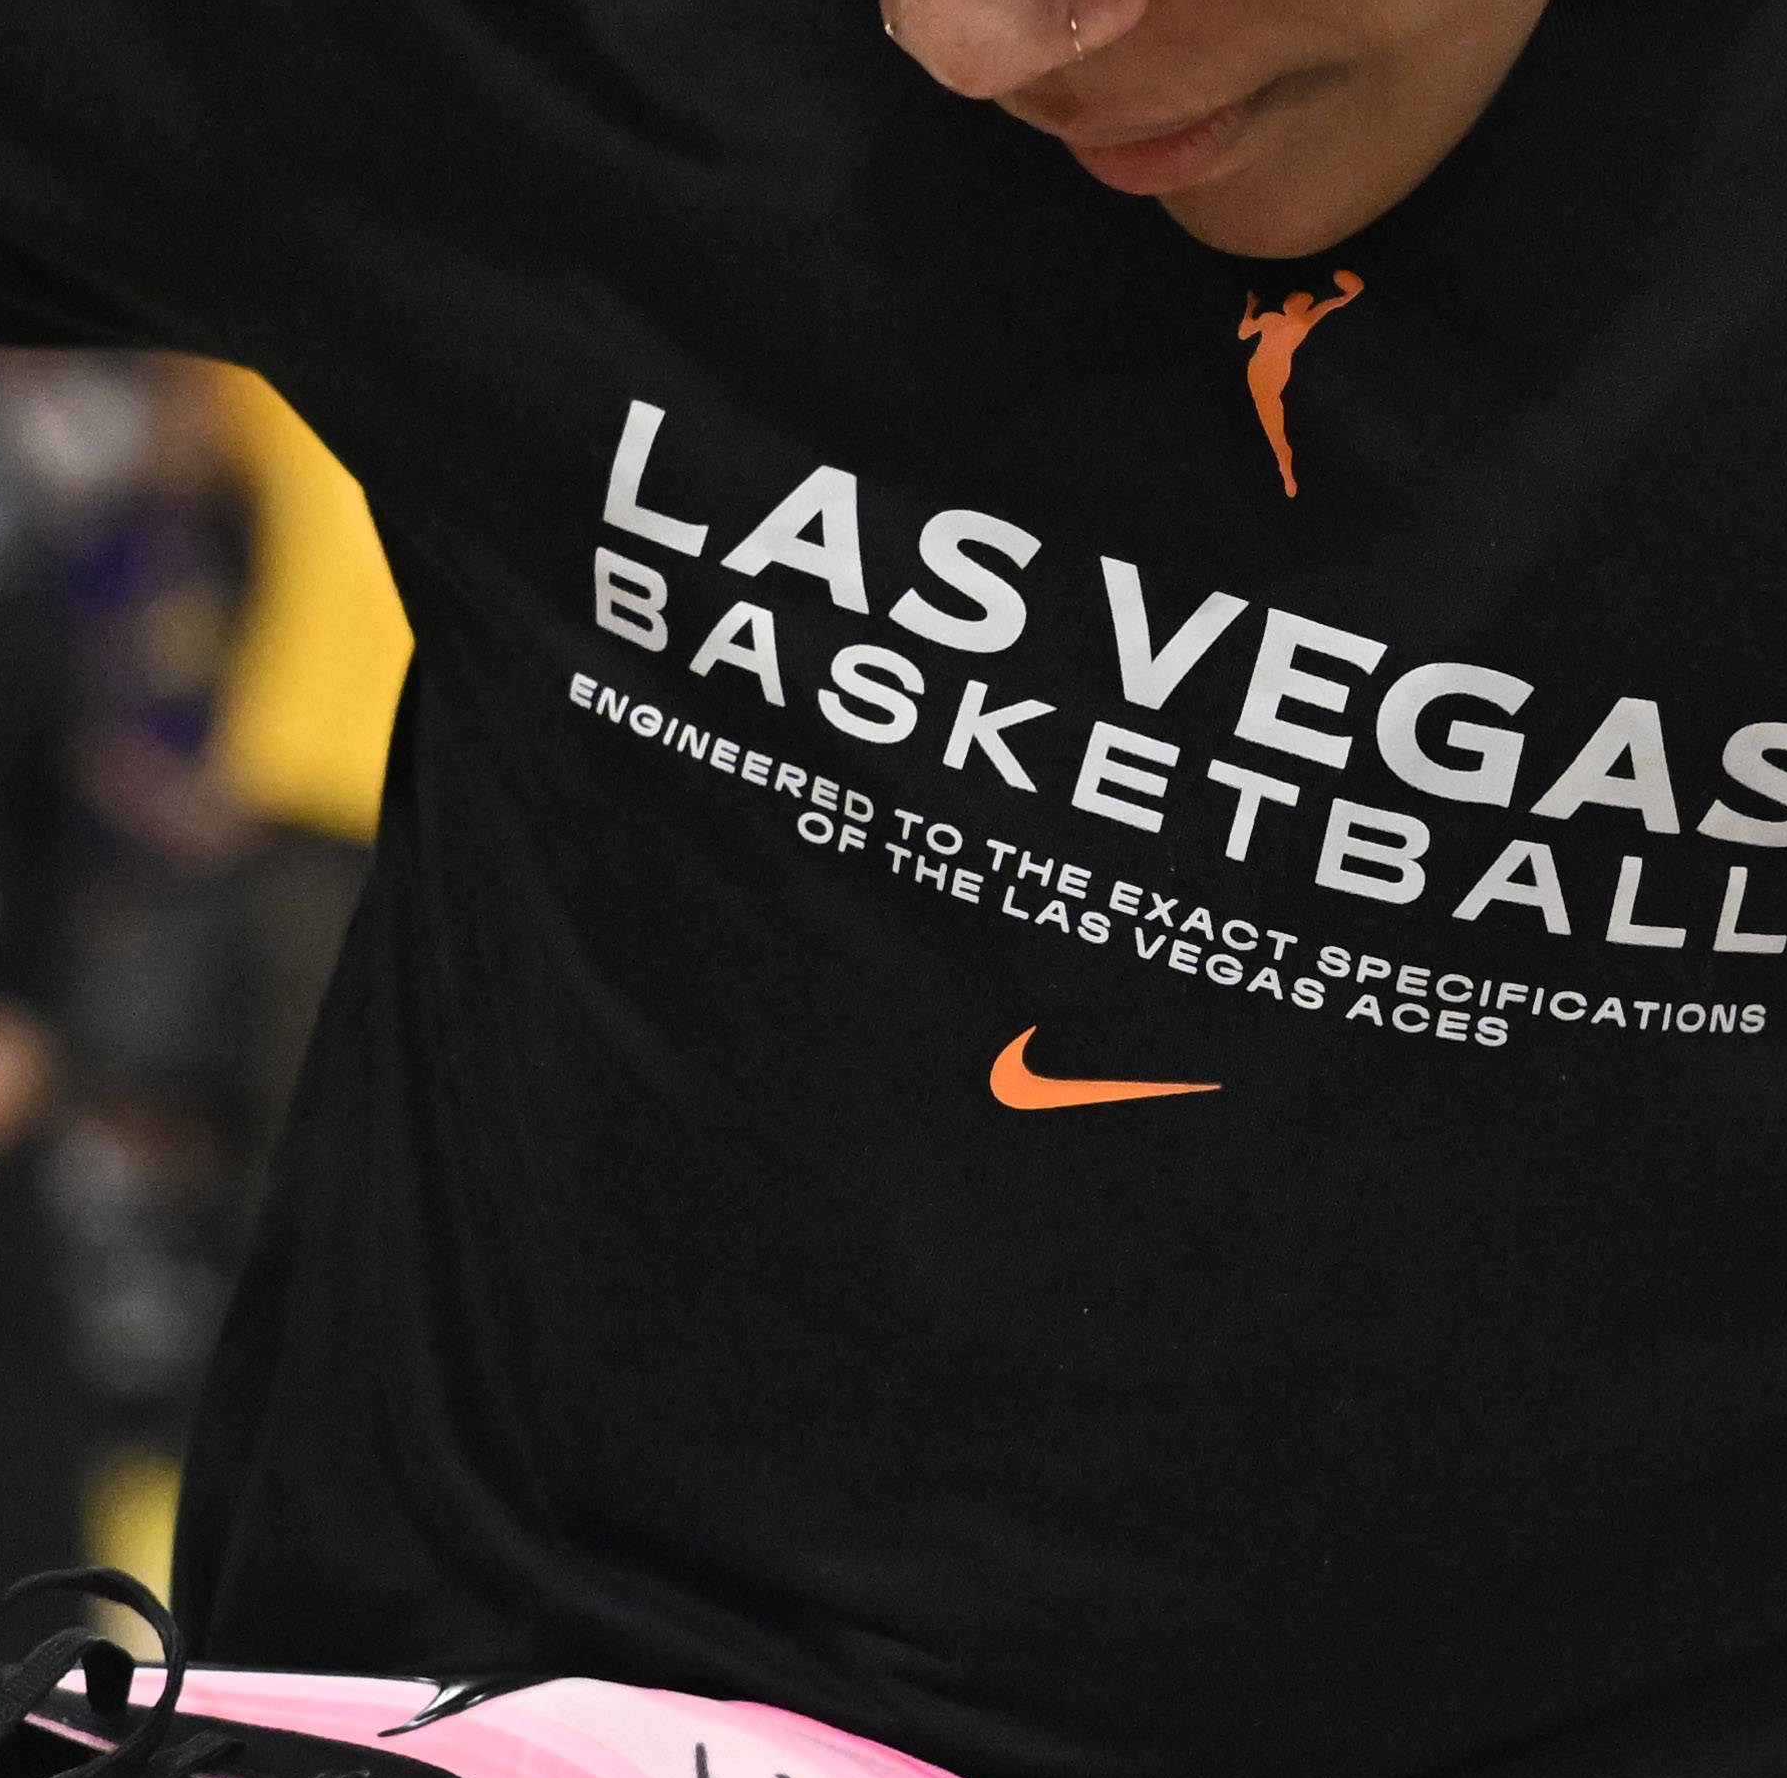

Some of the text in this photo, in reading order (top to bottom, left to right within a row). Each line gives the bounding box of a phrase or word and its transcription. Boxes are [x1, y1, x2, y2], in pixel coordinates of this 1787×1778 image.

[602, 399, 1043, 654] LAS
[569, 671, 1767, 1034] ENGINEERED TO THE EXACT SPECIFICATIONS
[796, 811, 1509, 1047] OF THE LAS VEGAS ACES
